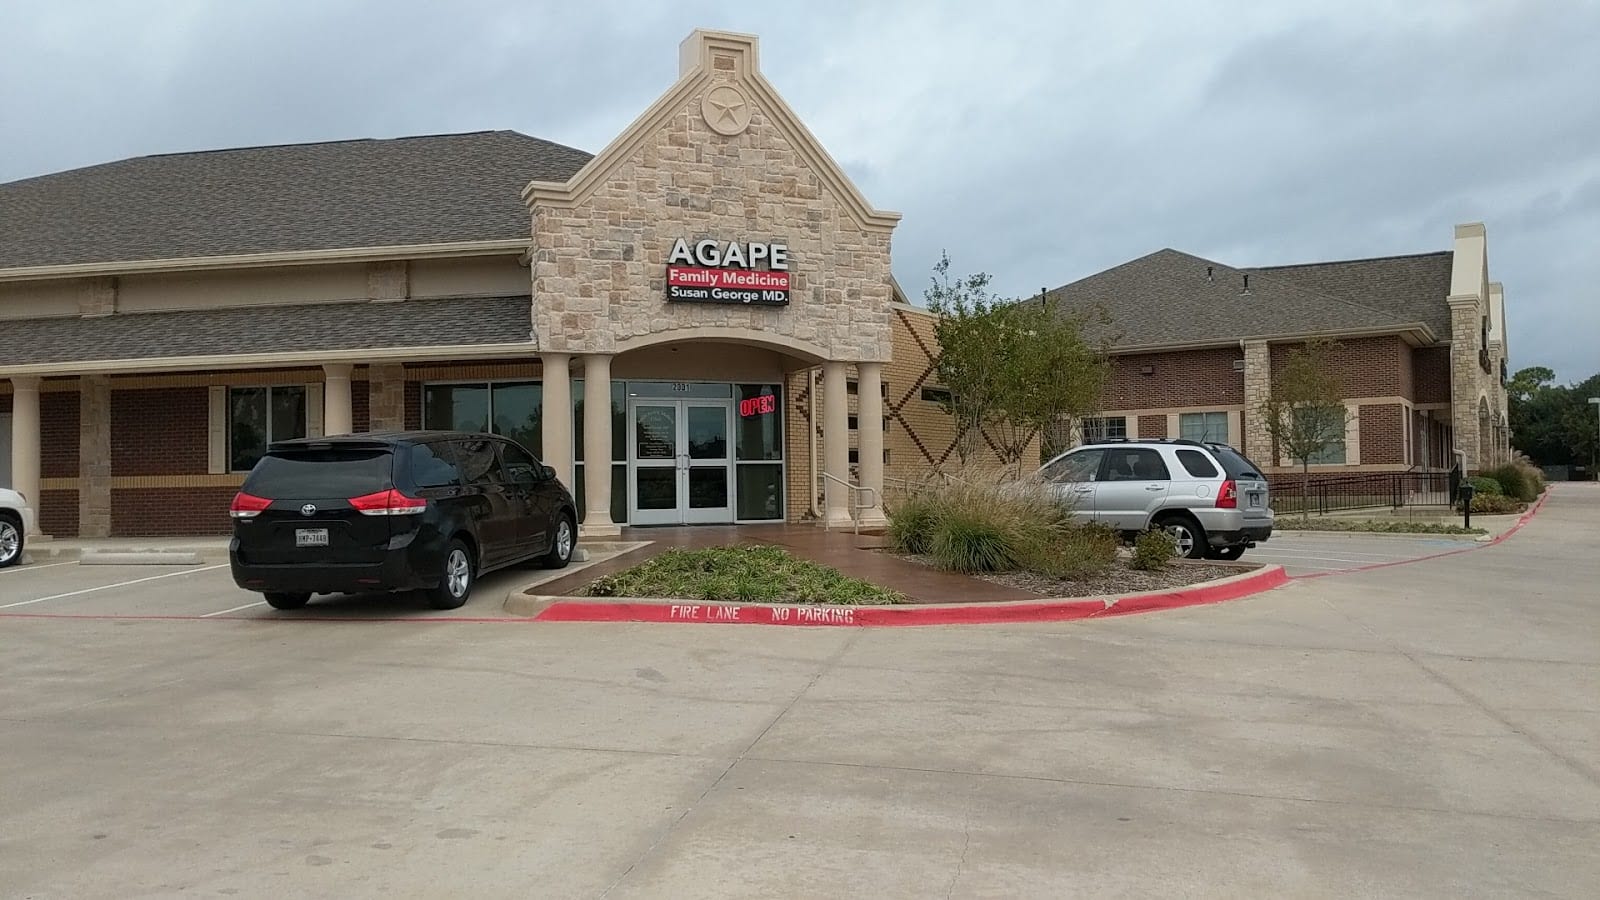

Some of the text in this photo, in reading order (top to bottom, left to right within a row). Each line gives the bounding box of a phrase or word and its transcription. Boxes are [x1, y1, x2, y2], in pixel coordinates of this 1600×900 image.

[668, 238, 789, 270] AGAPE
[669, 269, 788, 287] Family Medicine
[671, 286, 788, 303] Susan George MD.
[739, 394, 775, 417] OPEN
[670, 605, 855, 624] FIRE LANE NO PARKING
